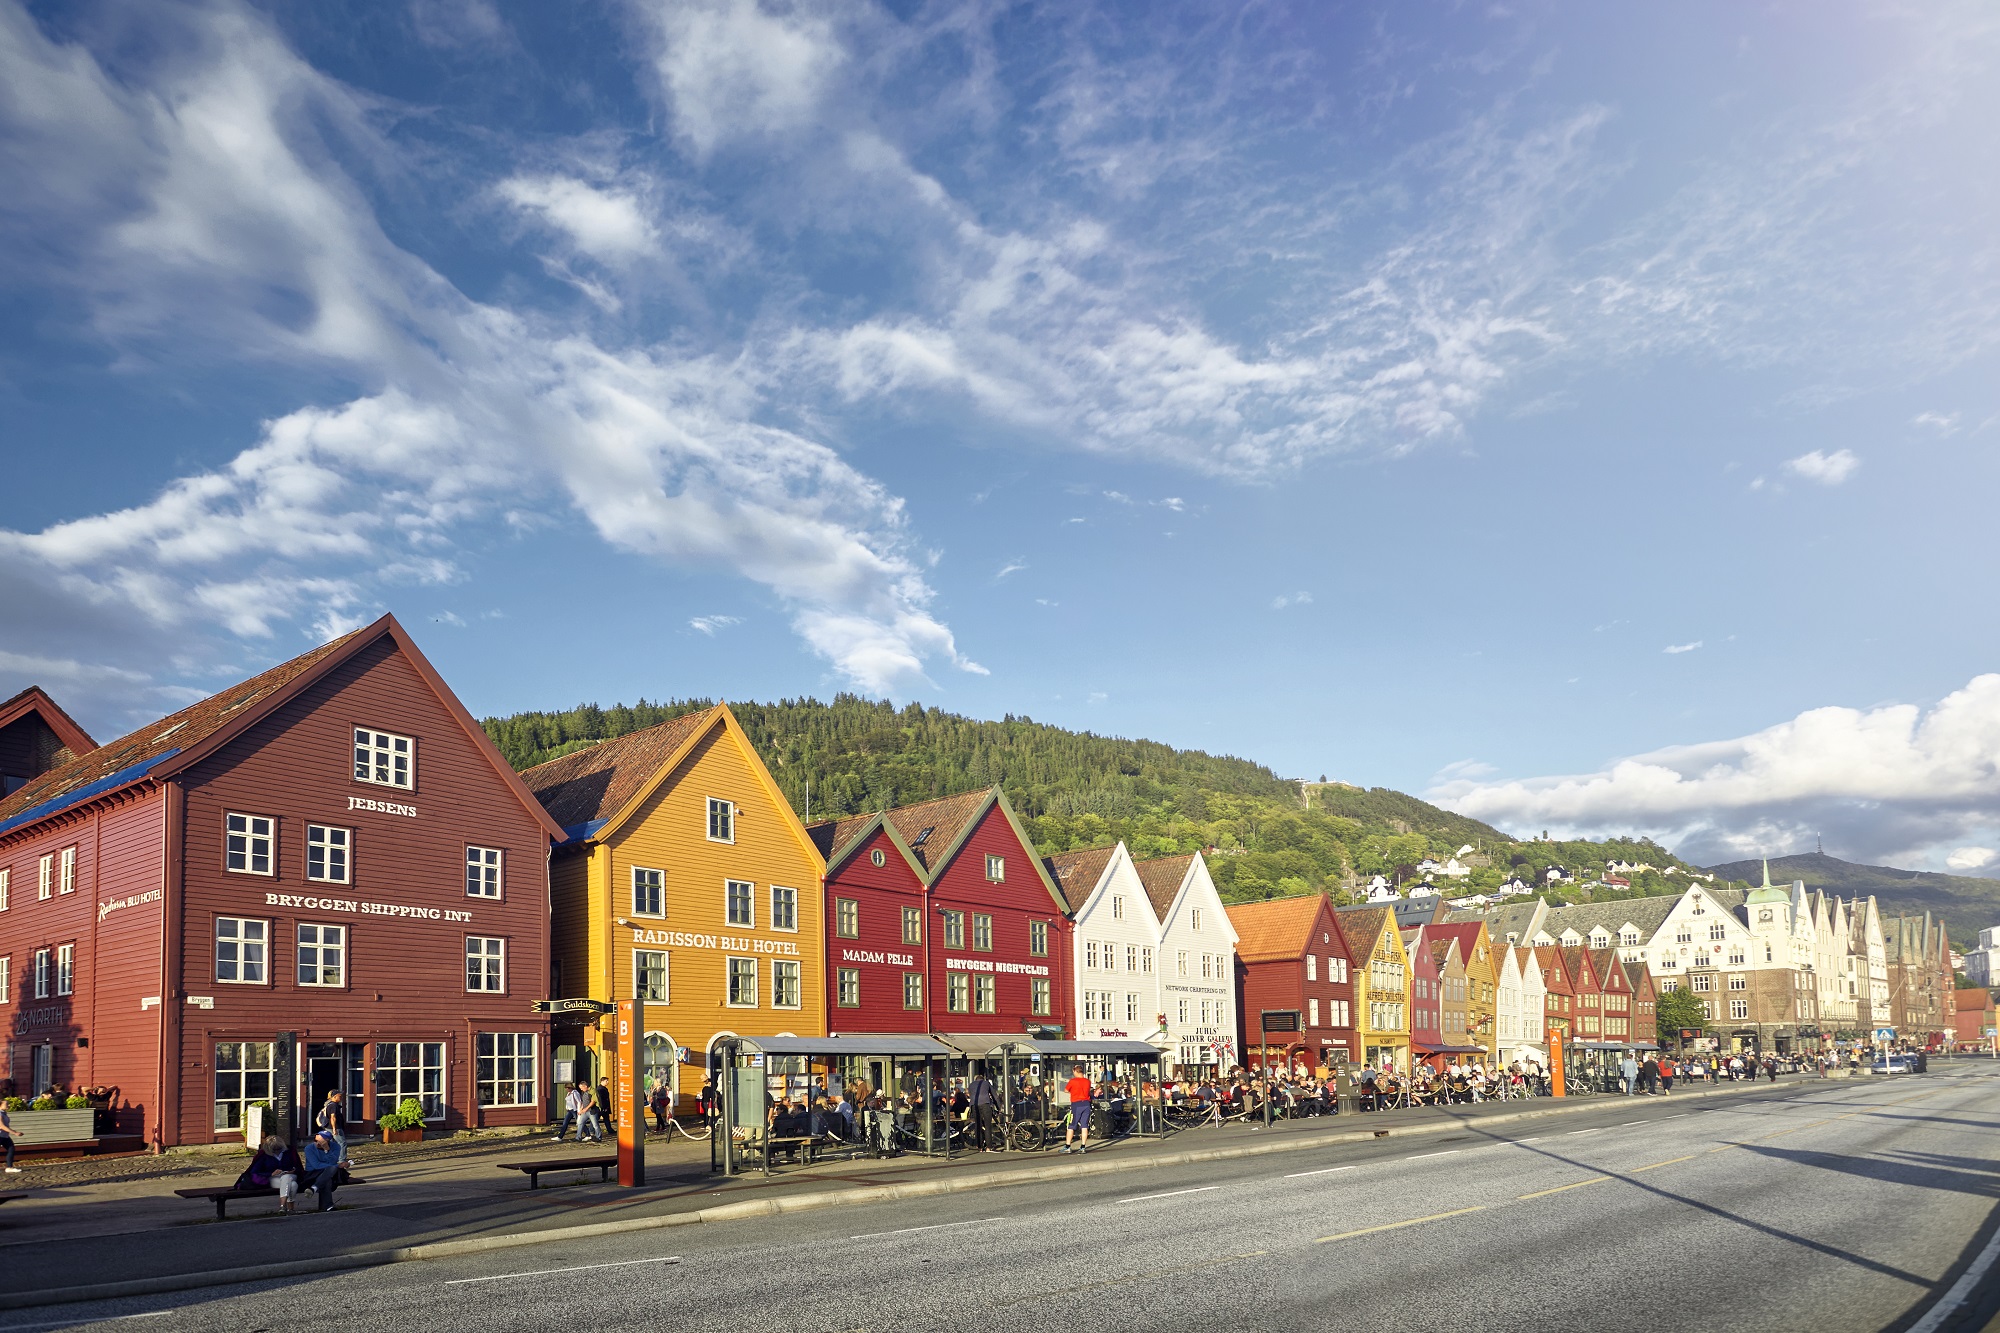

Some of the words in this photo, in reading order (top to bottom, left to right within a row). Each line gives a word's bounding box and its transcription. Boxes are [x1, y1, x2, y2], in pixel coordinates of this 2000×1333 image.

[347, 796, 417, 817] JEBSENS
[98, 897, 126, 923] Radisson
[127, 894, 140, 907] BLU
[140, 889, 162, 904] HOTEL
[265, 893, 358, 913] BRYGGEN
[361, 902, 441, 920] SHIPPING
[444, 910, 472, 922] INT
[632, 929, 716, 948] RADISSON
[720, 936, 749, 951] BLU
[753, 939, 800, 955] HOTEL
[843, 949, 884, 964] MADAM
[946, 958, 993, 971] BRYGGEN
[995, 962, 1049, 976] NIGHTCLUB
[1165, 984, 1189, 992] NETWORK
[1189, 986, 1218, 994] CHARTERING
[1367, 991, 1383, 1001] ALFRED
[29, 1005, 63, 1026] NORTH
[620, 1020, 628, 1036] B
[1181, 1035, 1205, 1043] SILVER
